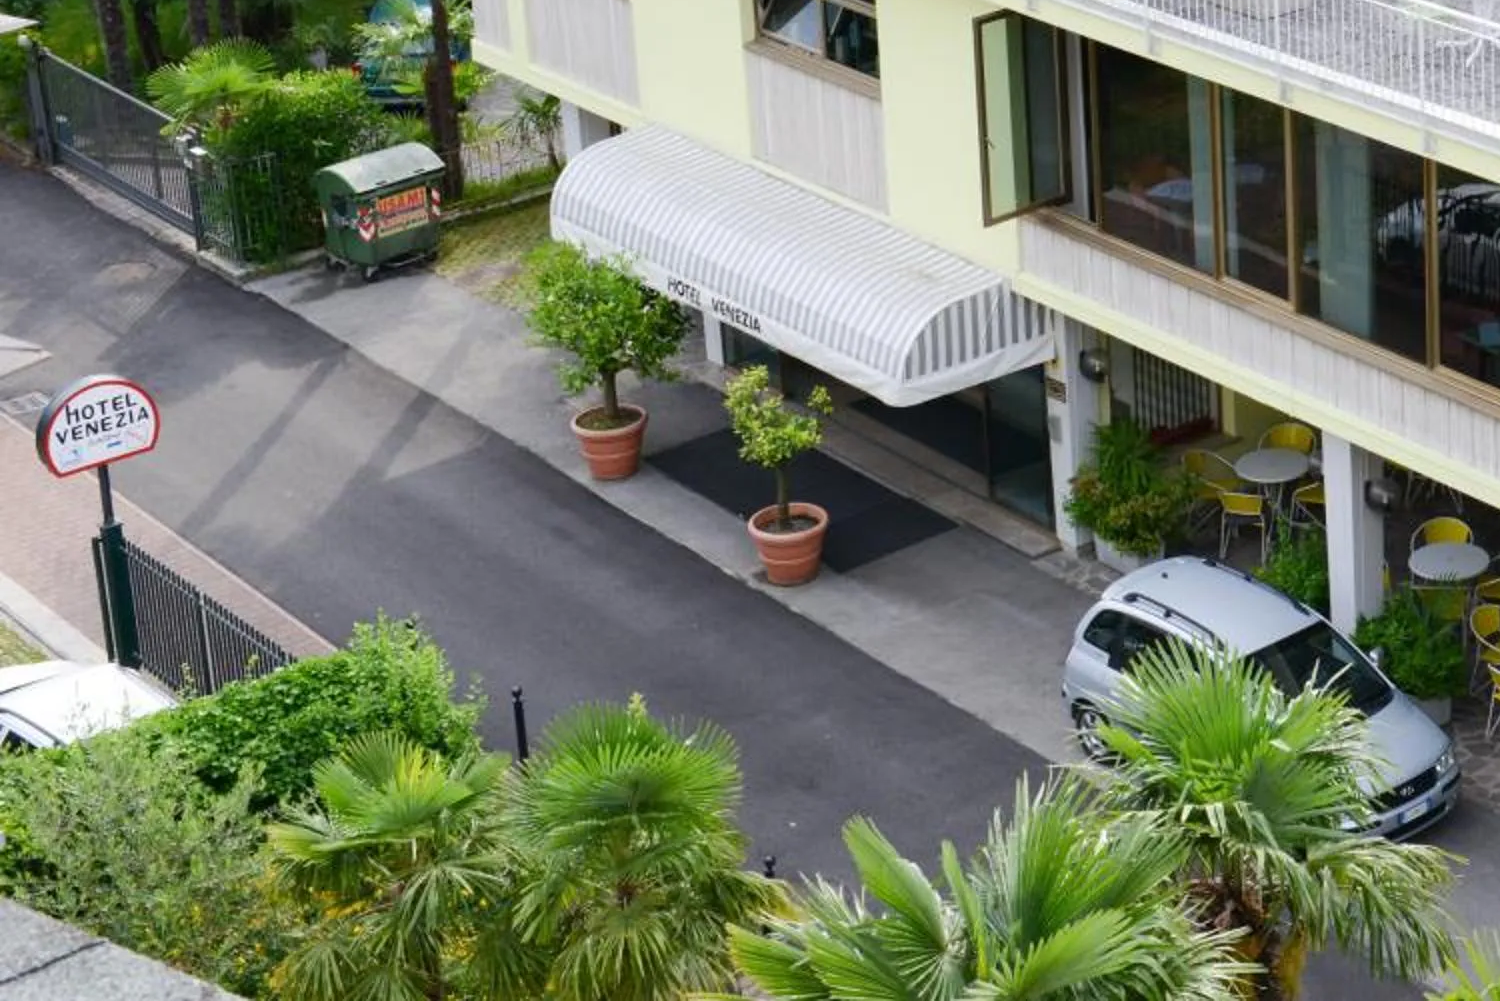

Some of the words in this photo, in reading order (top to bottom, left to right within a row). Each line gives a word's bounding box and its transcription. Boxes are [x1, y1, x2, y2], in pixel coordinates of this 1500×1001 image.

[667, 277, 702, 307] HOTEL
[711, 297, 761, 333] VENEZIA
[55, 406, 150, 446] VENEZIA
[65, 393, 137, 425] HOTEL
